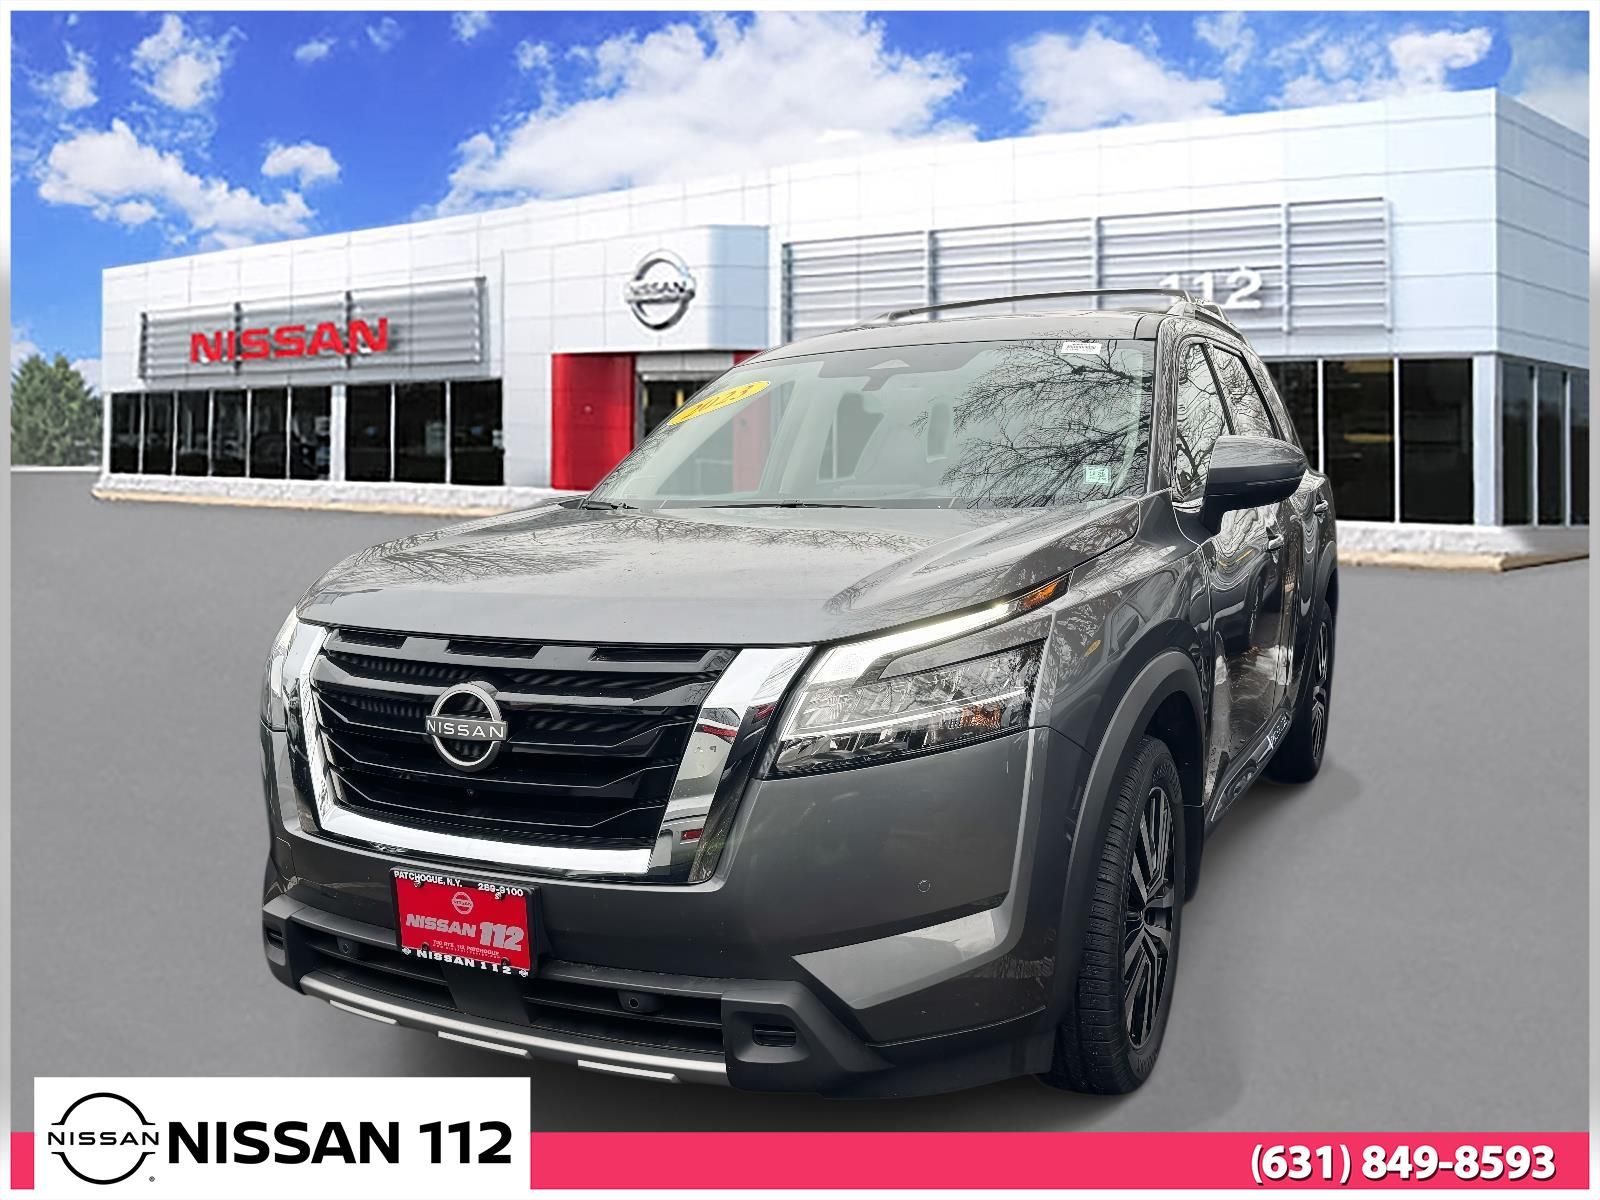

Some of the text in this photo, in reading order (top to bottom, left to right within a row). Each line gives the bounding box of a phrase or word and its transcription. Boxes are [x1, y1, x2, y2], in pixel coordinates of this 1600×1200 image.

[1159, 270, 1262, 309] 112
[190, 317, 388, 363] NISSAN
[426, 719, 504, 738] NISSAN
[446, 878, 463, 887] N.Y.
[406, 913, 524, 951] NISSAN 112
[416, 949, 475, 967] NISSAN
[480, 962, 512, 975] 112
